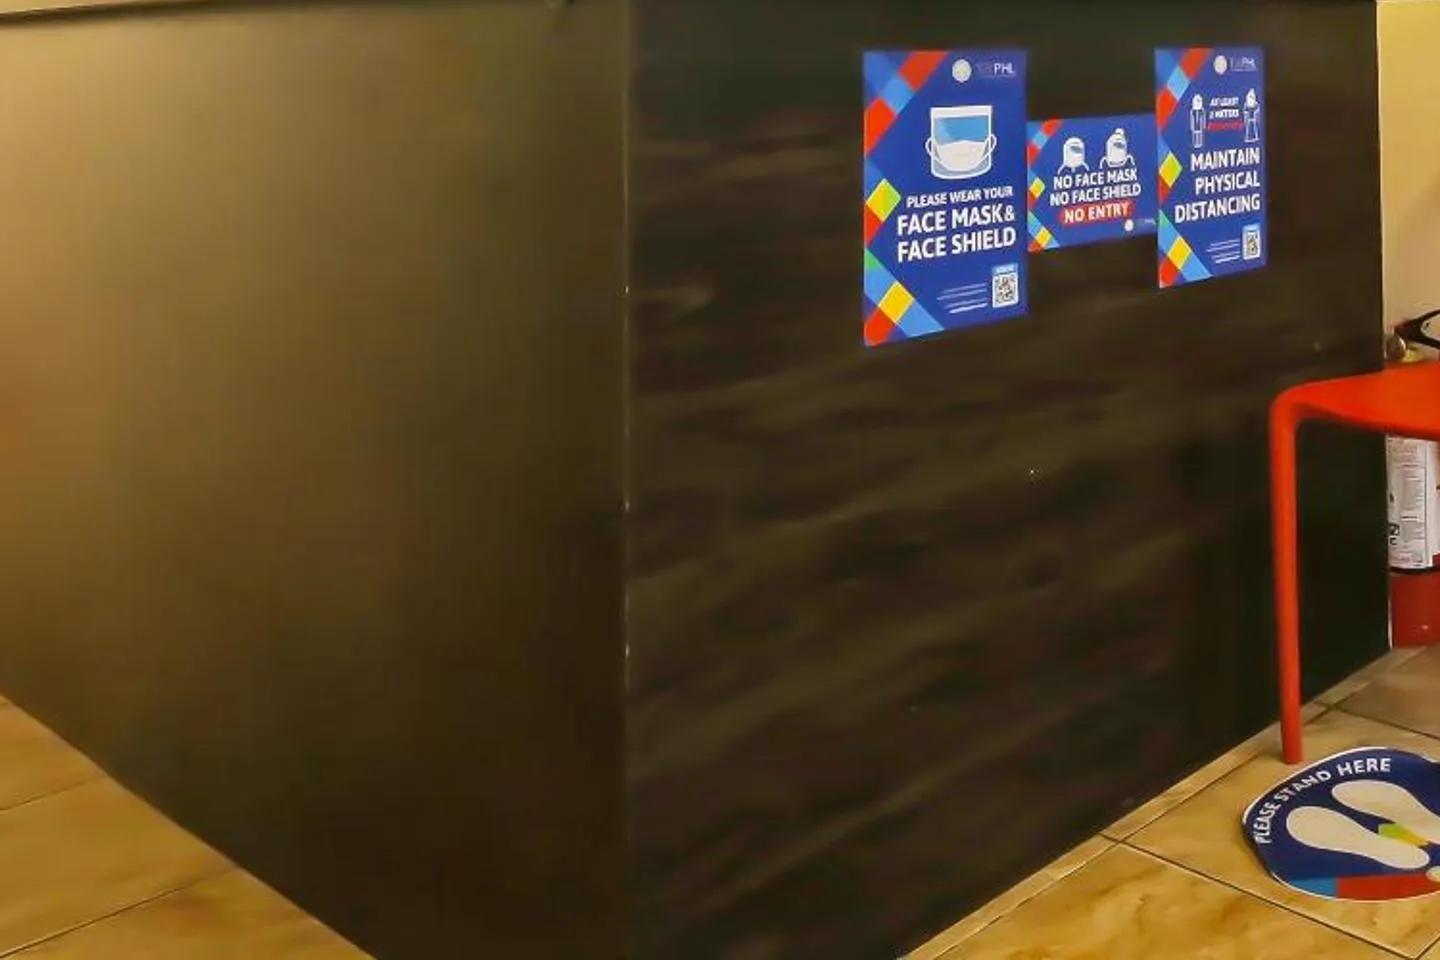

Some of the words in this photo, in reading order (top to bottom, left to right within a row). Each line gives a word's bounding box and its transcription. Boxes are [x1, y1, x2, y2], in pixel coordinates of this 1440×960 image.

[1191, 147, 1260, 172] MAINTAIN
[1053, 175, 1072, 190] NO
[1075, 171, 1103, 187] FACE
[1106, 168, 1138, 184] MASK
[1195, 170, 1260, 195] PHYSICAL
[907, 193, 947, 209] PLEASE
[950, 189, 982, 204] WEAR
[984, 186, 1014, 200] YOUR
[1050, 191, 1069, 206] NO
[1072, 187, 1100, 203] FACE
[1102, 183, 1141, 200] SHIELD
[1064, 208, 1085, 223] NO
[1088, 202, 1130, 220] ENTRY
[1174, 193, 1260, 224] DISTANCING
[897, 212, 947, 236] FACE
[897, 237, 947, 263] FACE
[951, 227, 1017, 257] SHIELD
[1253, 802, 1281, 844] PLEASE
[1275, 769, 1332, 803] STAND
[1336, 757, 1392, 776] HERE
